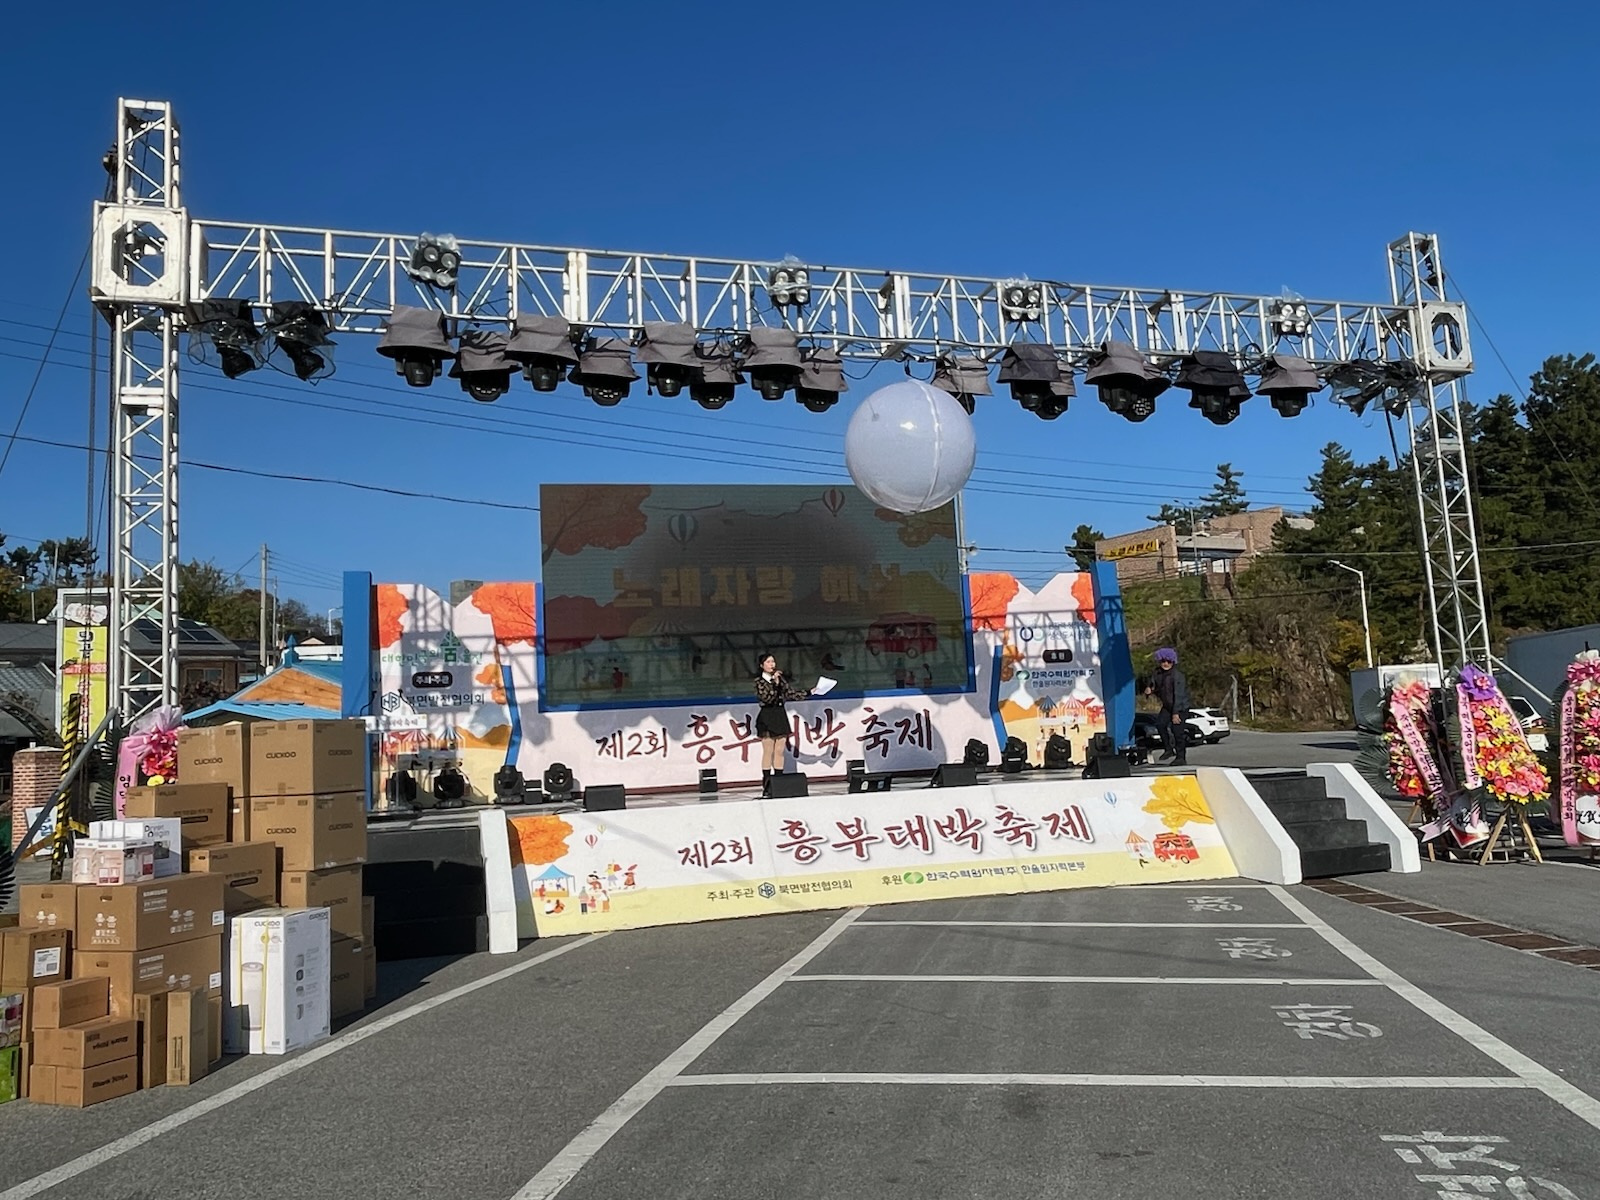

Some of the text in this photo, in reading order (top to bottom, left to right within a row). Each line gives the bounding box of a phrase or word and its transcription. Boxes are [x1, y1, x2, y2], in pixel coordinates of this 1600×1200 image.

[595, 706, 933, 764] 제2회 흥부박 축제
[193, 757, 223, 766] CUCKOO
[266, 751, 296, 759] CUCKOO
[266, 827, 297, 835] CUCKOO
[328, 823, 353, 831] CUCKOO
[678, 836, 753, 869] 제2회
[779, 879, 853, 895] 북면발전협의회
[881, 874, 903, 886] 후원
[1215, 936, 1293, 959] 경차
[1270, 1003, 1384, 1040] 경차
